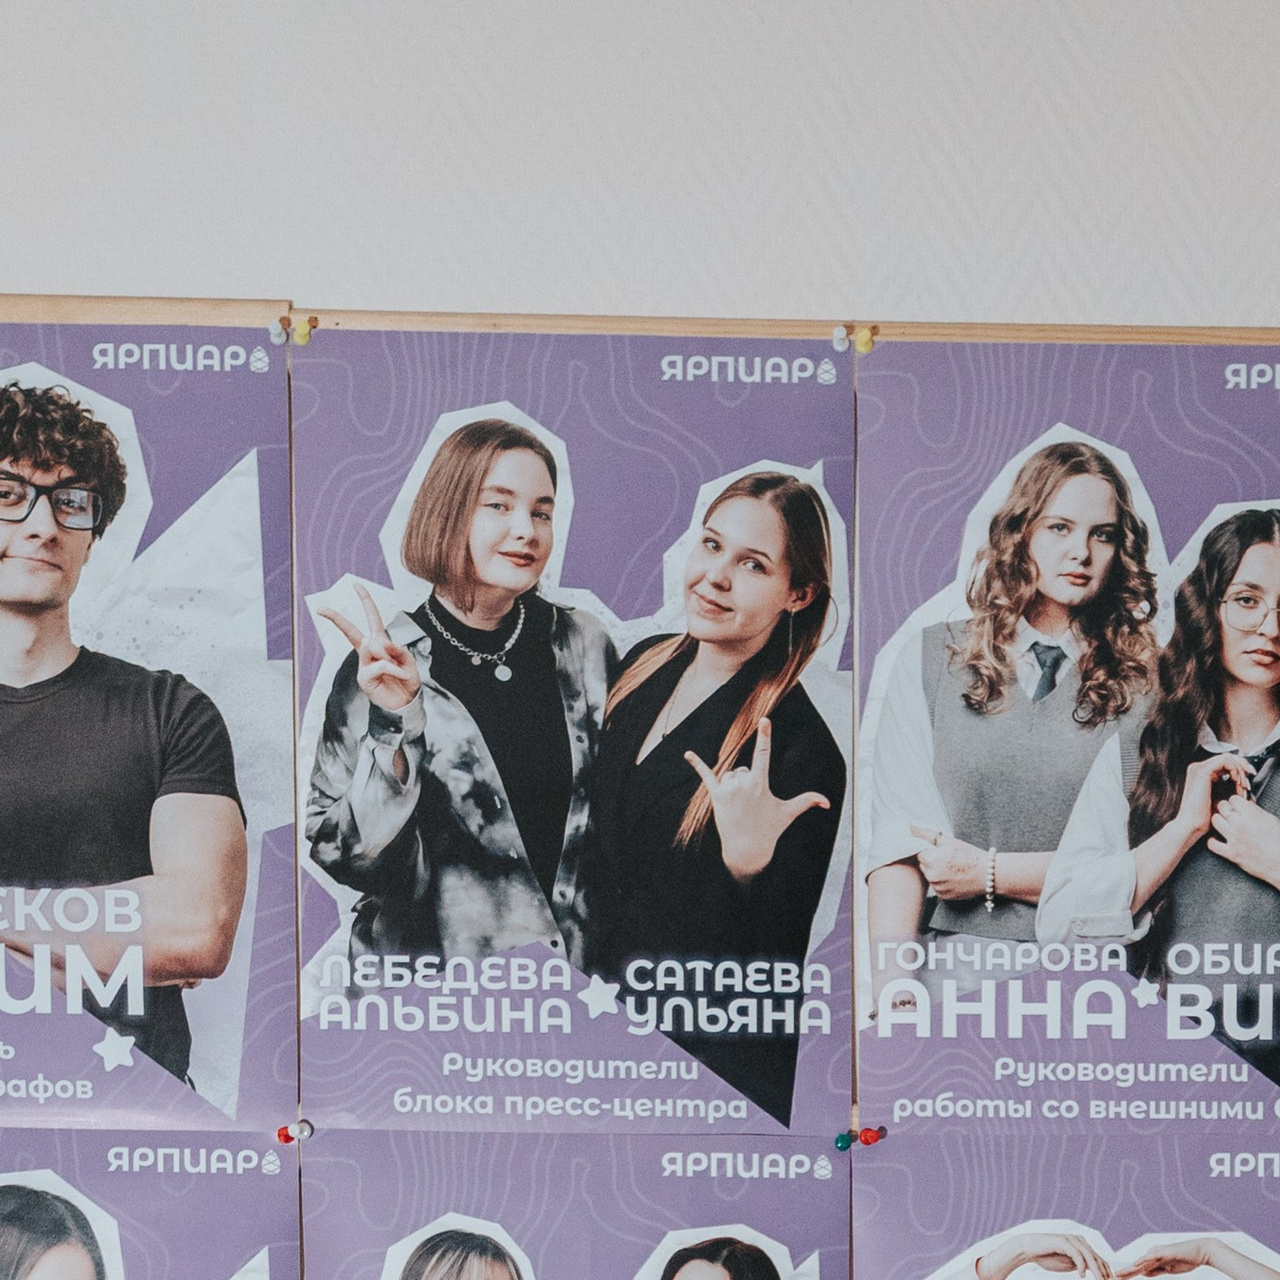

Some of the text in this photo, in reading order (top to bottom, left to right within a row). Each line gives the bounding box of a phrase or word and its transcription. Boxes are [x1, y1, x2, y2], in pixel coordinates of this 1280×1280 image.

[92, 342, 247, 372] ЯРПИАР
[660, 355, 815, 384] ЯРПИАР
[0, 887, 142, 932] КОВ
[877, 941, 1127, 972] ГОНЧАРОВА
[320, 955, 572, 995] ЛЕБЕДЕВА
[625, 959, 831, 994] САТАЕВА
[319, 994, 572, 1034] АЛЬБИНА
[626, 996, 831, 1036] УЛЬЯНА
[877, 977, 1127, 1039] АННА
[442, 1052, 699, 1084] Руководители
[995, 1056, 1249, 1088] Руководители
[393, 1086, 748, 1124] блока пресс-центра
[893, 1091, 1032, 1123] работы
[1042, 1101, 1080, 1119] со
[1089, 1100, 1264, 1121] внешними
[107, 1146, 259, 1175] ЯРПИАР
[661, 1151, 811, 1179] ЯРПИАР
